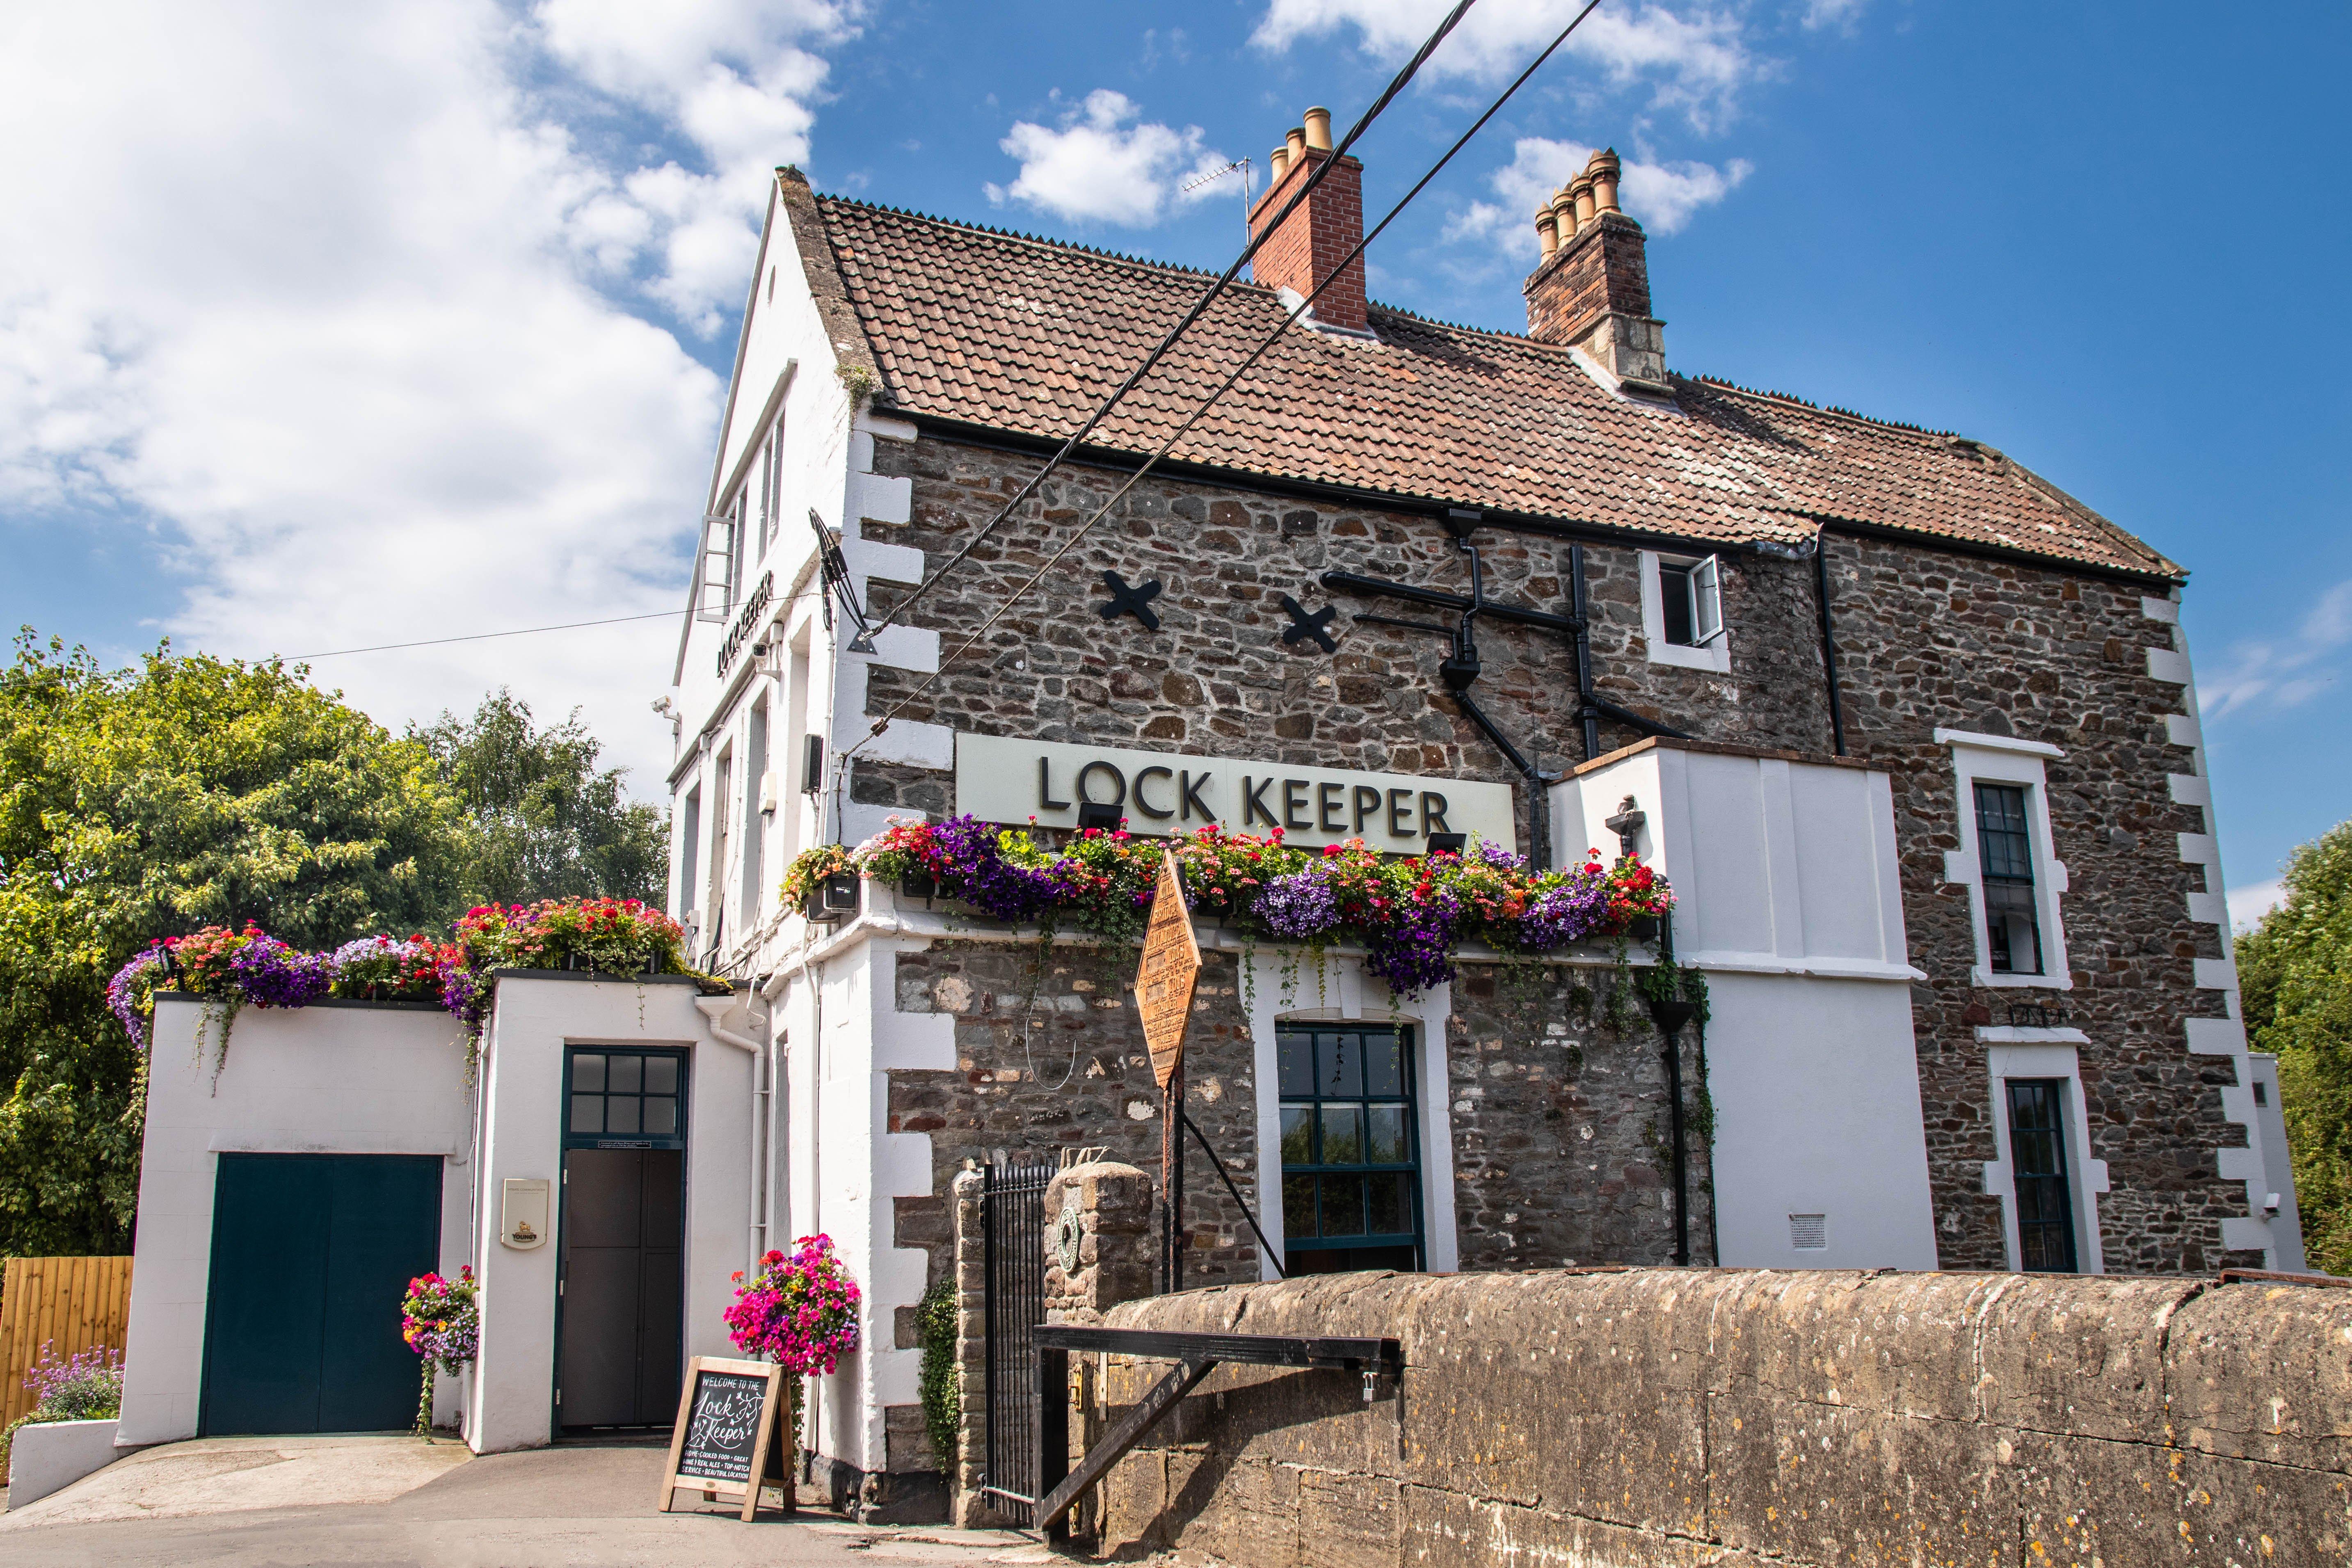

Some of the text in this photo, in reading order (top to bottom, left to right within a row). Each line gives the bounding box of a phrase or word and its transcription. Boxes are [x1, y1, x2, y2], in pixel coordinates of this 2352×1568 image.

[1040, 757, 1451, 838] LOCK KEEPER
[1155, 902, 1177, 924] BRIDGE
[1169, 944, 1184, 963] TONS
[1168, 974, 1185, 993] TONS
[702, 1376, 760, 1390] WELCOME TO THE
[694, 1392, 735, 1421] Lock
[705, 1420, 745, 1449] Keeper
[682, 1465, 701, 1474] SERVICE
[704, 1468, 727, 1477] BEAUTIFUL
